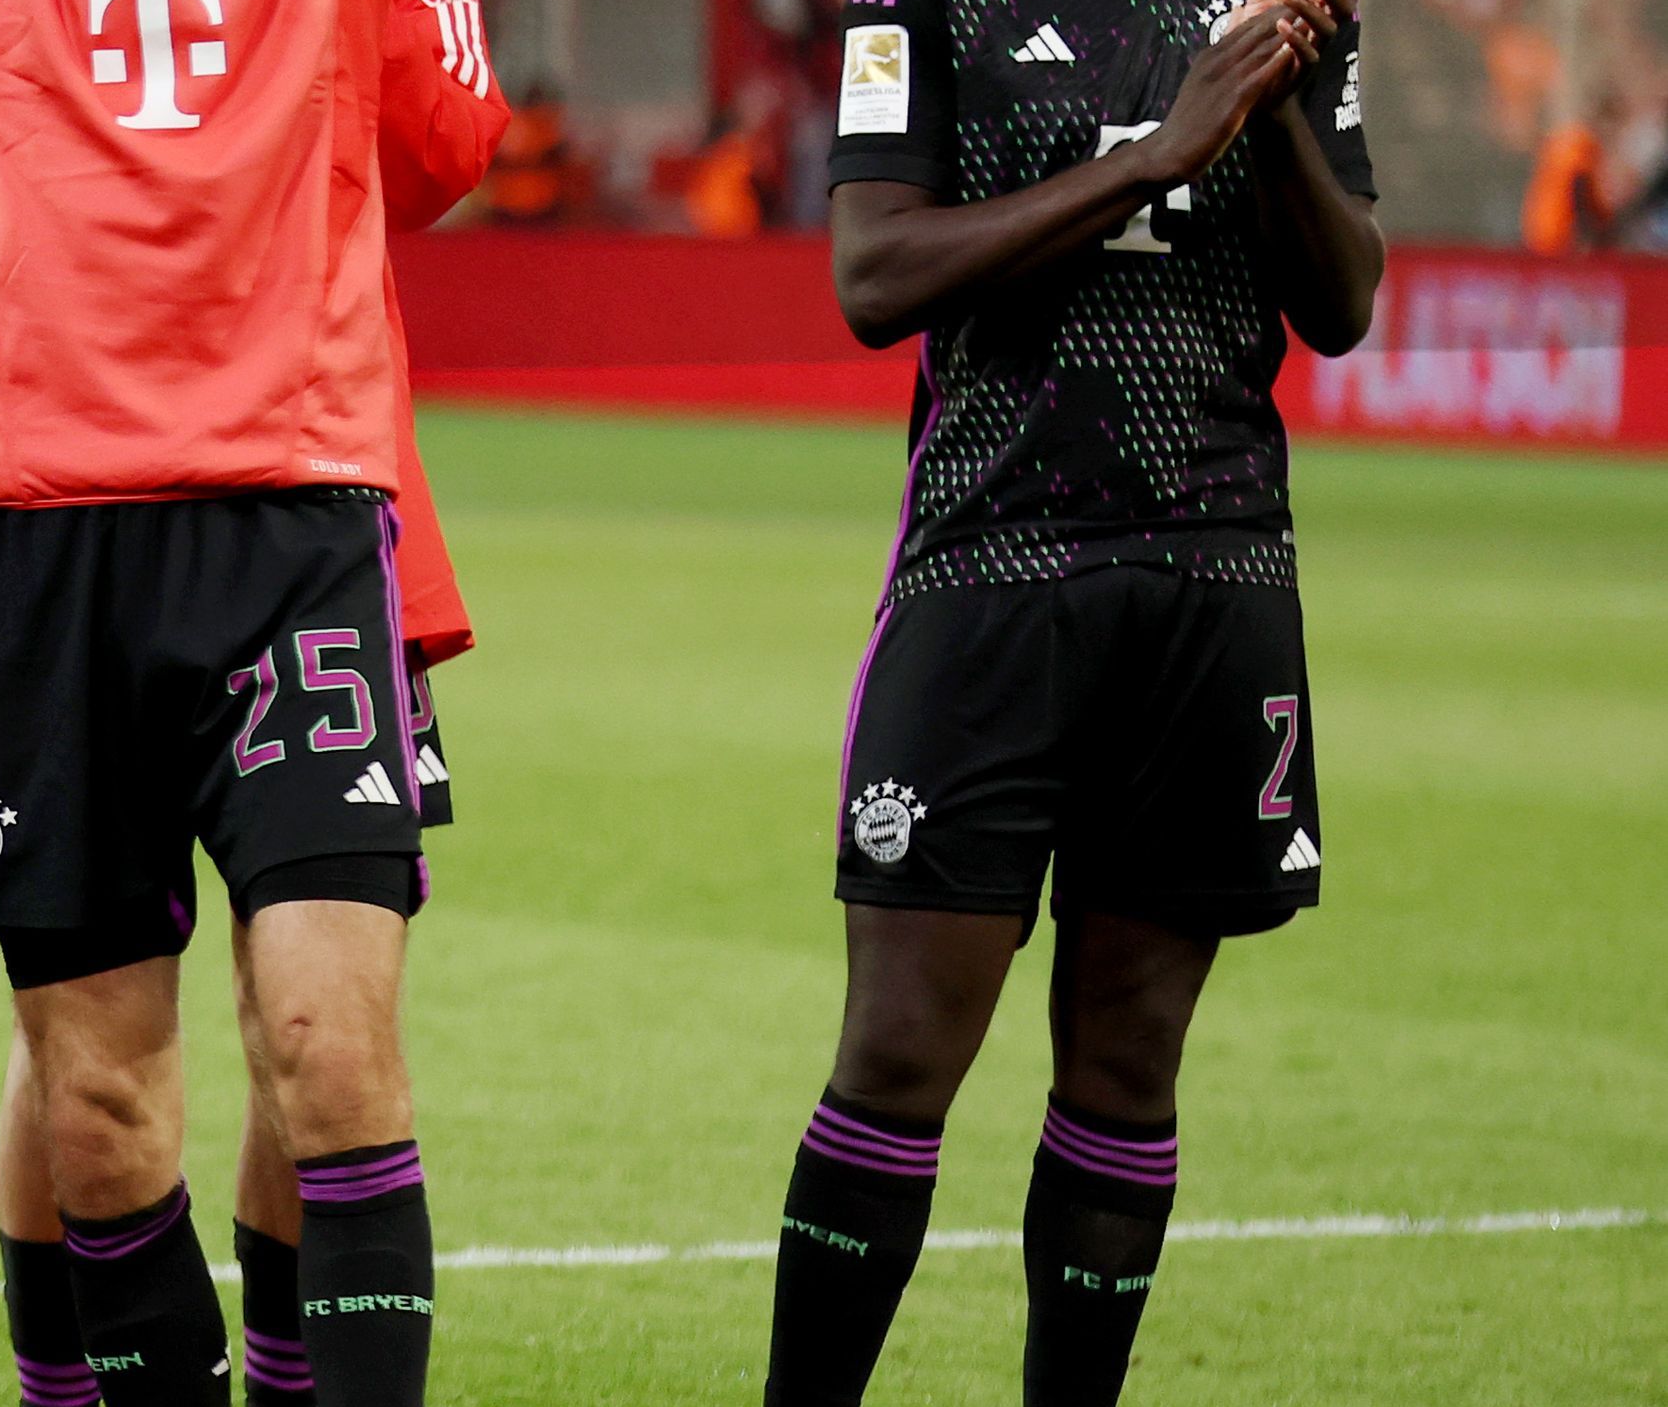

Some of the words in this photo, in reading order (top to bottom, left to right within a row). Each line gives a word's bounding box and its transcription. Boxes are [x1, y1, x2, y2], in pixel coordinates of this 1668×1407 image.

[227, 628, 378, 778] 25
[1258, 694, 1299, 821] 2
[305, 1297, 331, 1318] FC
[338, 1293, 434, 1317] BAYERN
[1064, 1265, 1101, 1289] FC
